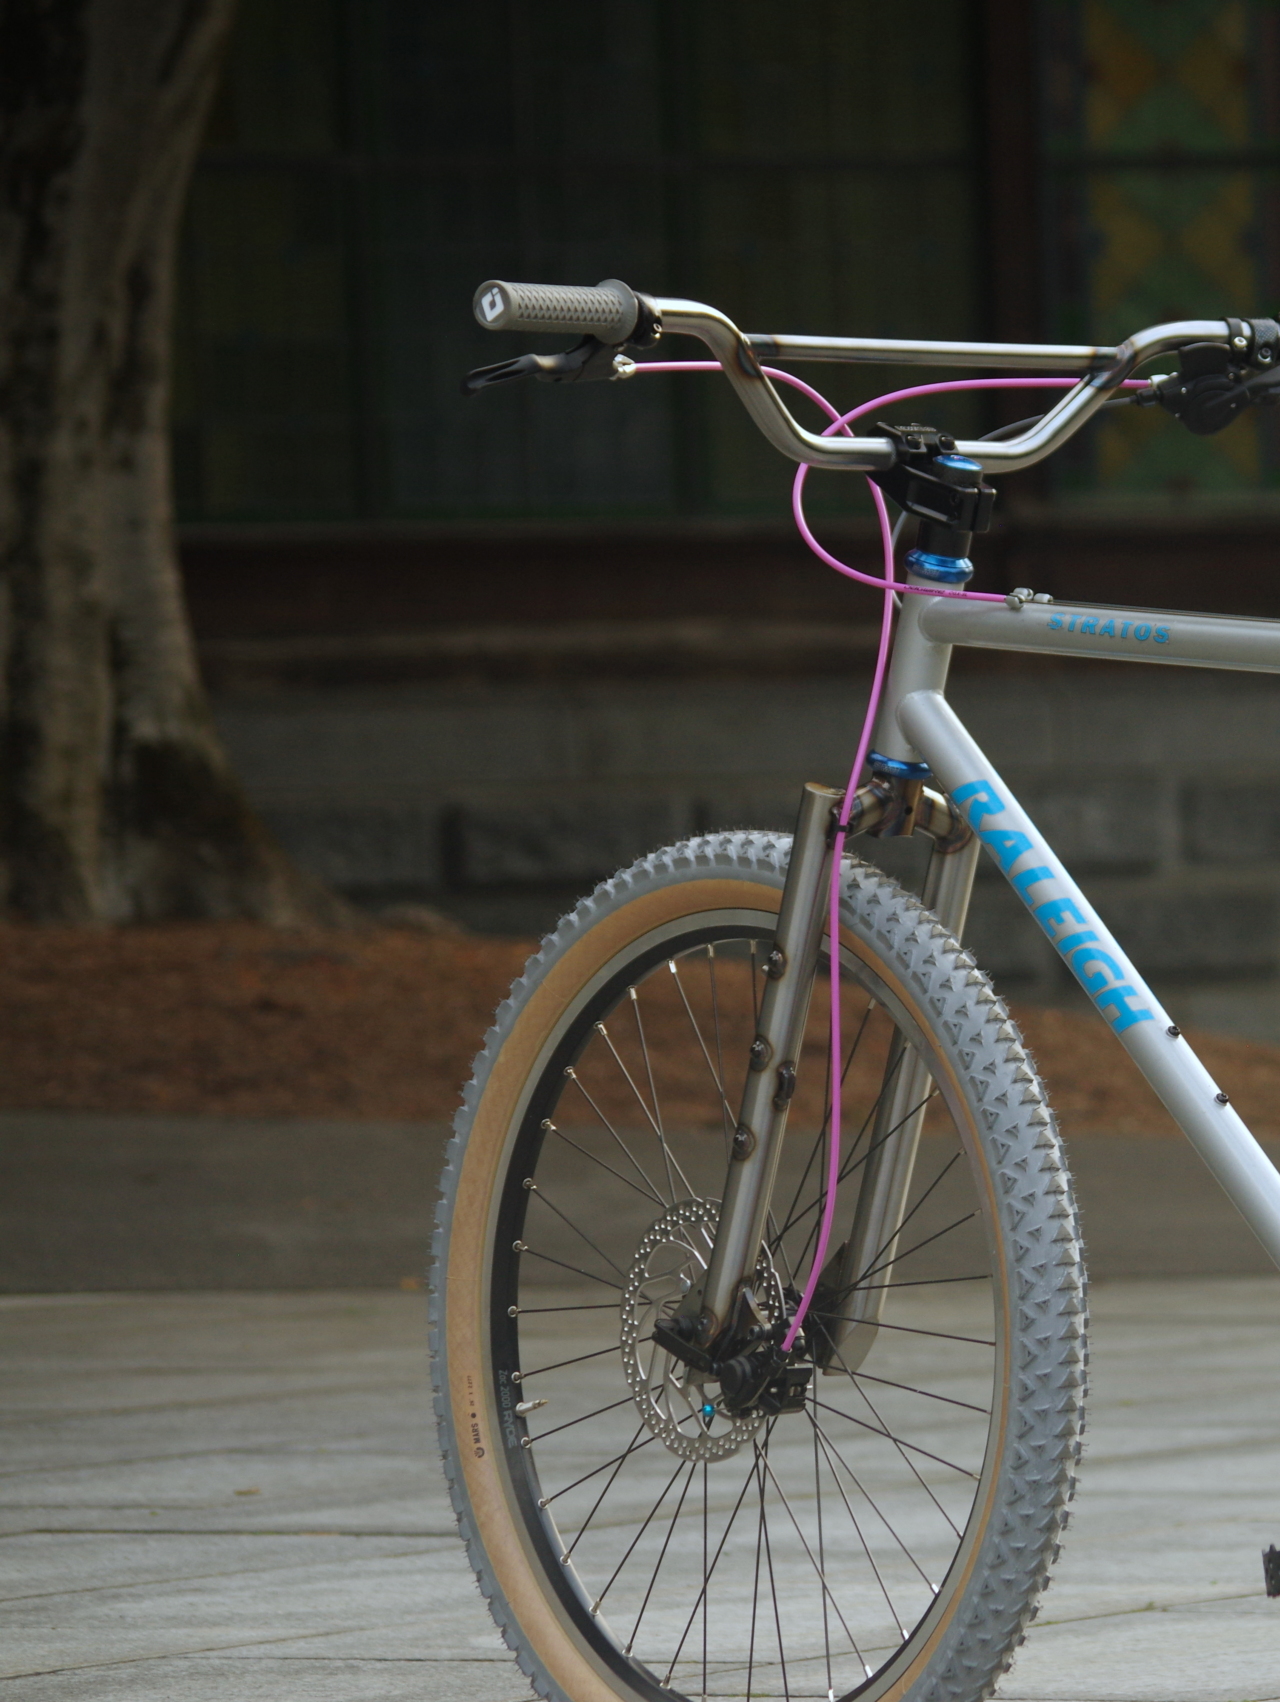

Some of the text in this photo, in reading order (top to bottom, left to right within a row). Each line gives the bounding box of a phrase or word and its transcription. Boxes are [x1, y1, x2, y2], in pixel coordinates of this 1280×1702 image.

[1047, 612, 1172, 644] STRATOS
[951, 779, 1155, 1034] RALEIGH
[500, 1386, 511, 1408] 2000
[471, 1422, 481, 1444] MARS
[503, 1410, 517, 1449] RYDE
